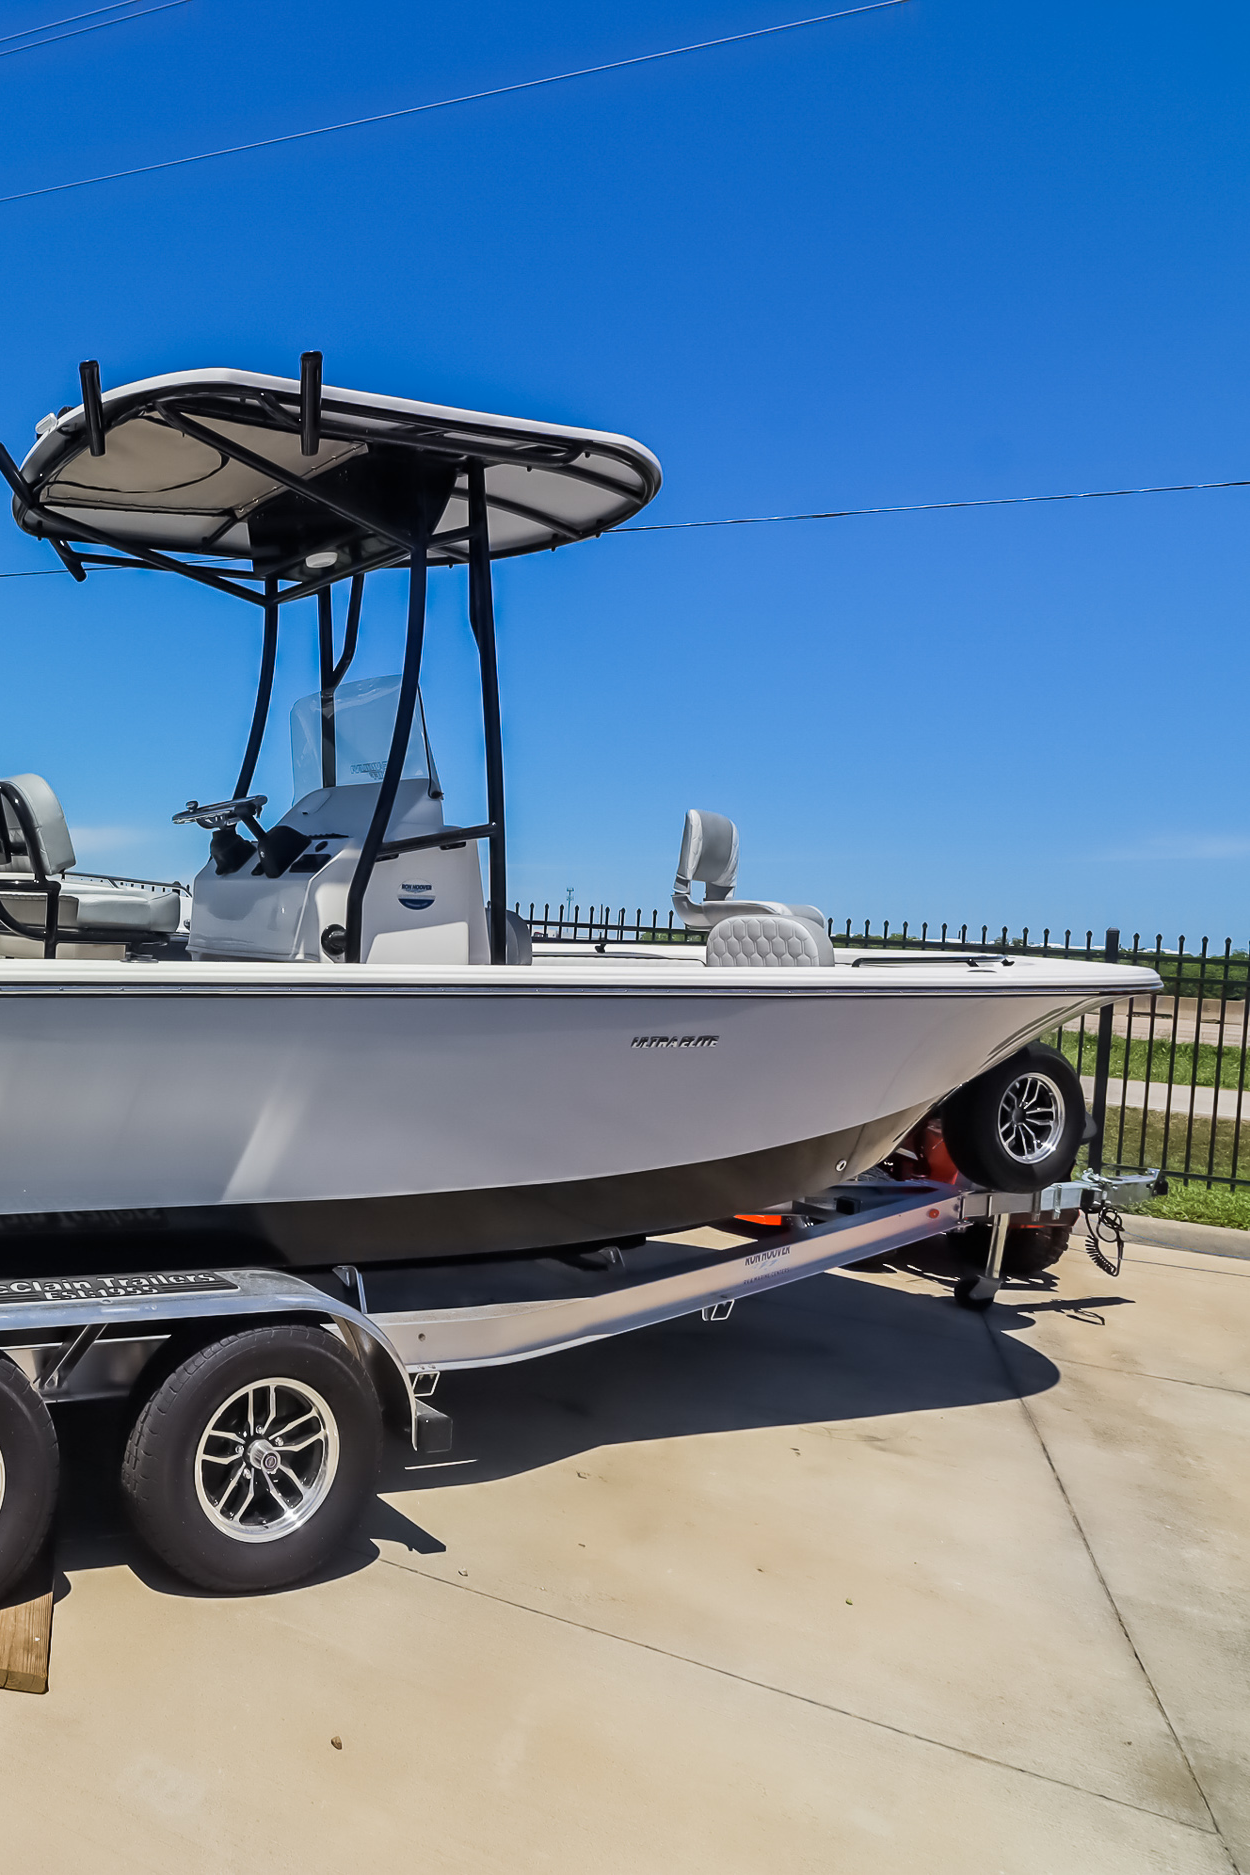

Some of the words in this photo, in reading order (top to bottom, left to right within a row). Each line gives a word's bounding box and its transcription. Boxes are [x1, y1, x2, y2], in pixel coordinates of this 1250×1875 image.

[631, 1035, 678, 1049] ULTRA
[679, 1035, 720, 1048] ELITE
[97, 1271, 217, 1287] Trailers
